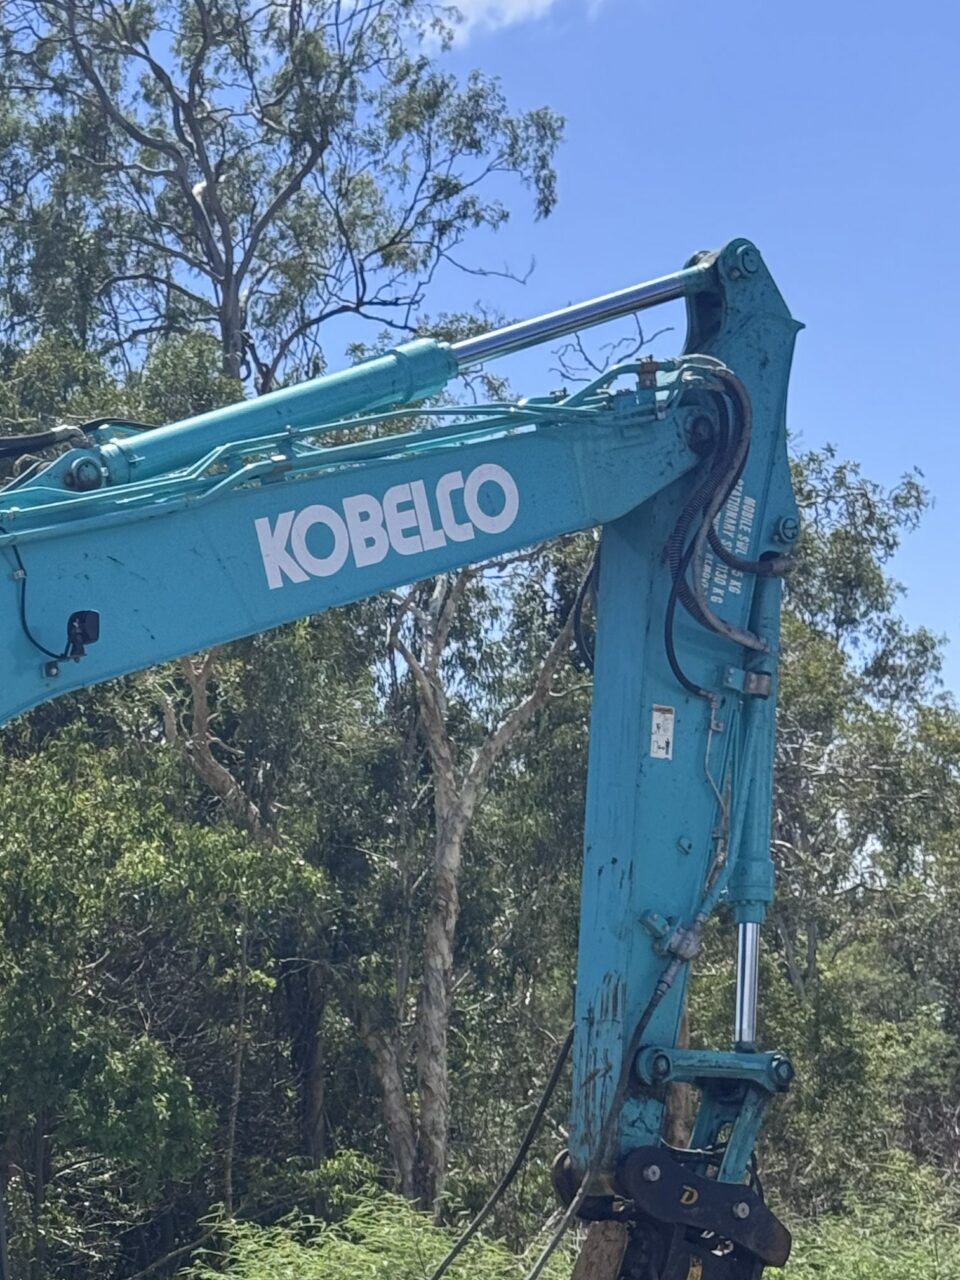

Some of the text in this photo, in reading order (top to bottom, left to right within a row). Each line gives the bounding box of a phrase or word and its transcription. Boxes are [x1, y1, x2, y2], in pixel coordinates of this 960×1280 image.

[254, 463, 519, 590] KOBELCO
[739, 496, 756, 533] MOBILE
[710, 587, 725, 604] KG
[728, 579, 743, 595] KG
